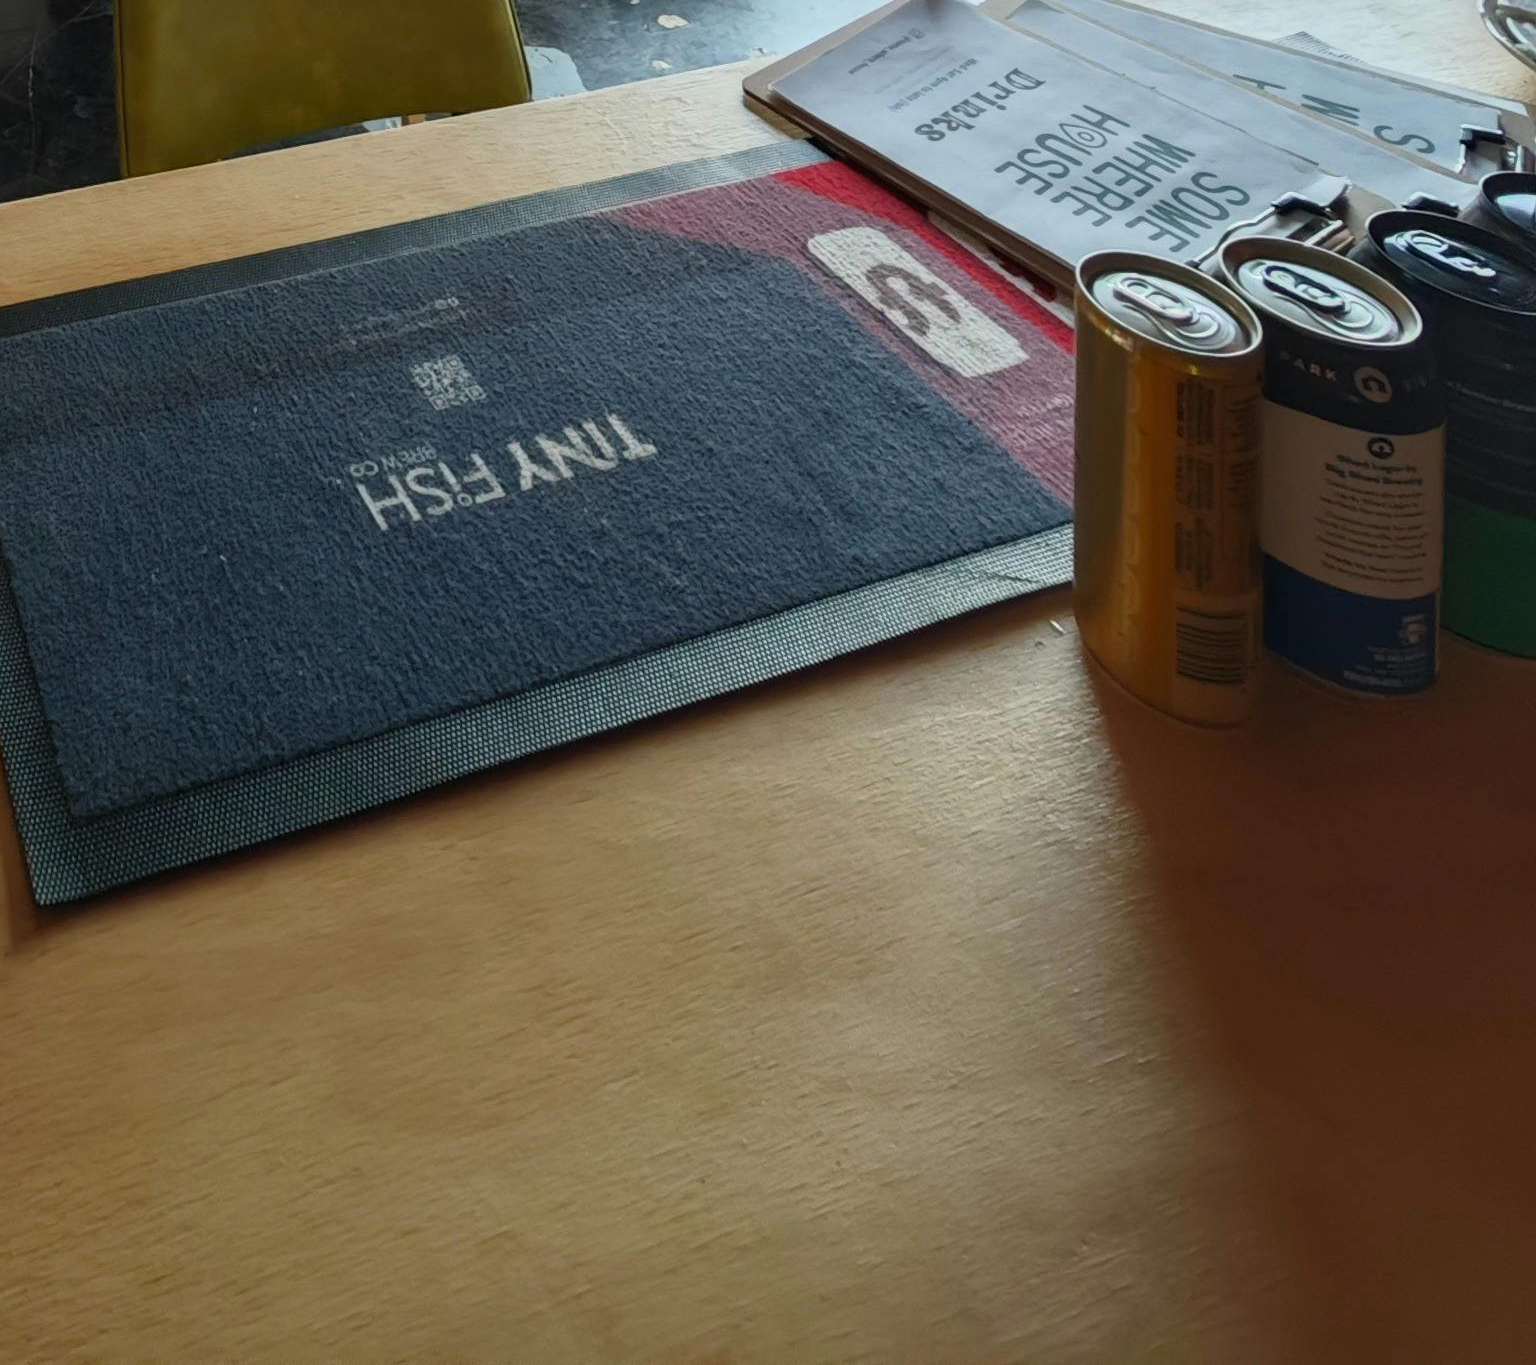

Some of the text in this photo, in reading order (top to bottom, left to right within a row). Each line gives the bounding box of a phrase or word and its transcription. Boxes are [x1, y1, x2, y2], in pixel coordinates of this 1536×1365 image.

[914, 67, 1047, 142] Drinks
[993, 104, 1131, 195] HOUSE
[1049, 133, 1196, 227] WHERE
[1124, 171, 1250, 253] SOME
[506, 412, 658, 491] TINY
